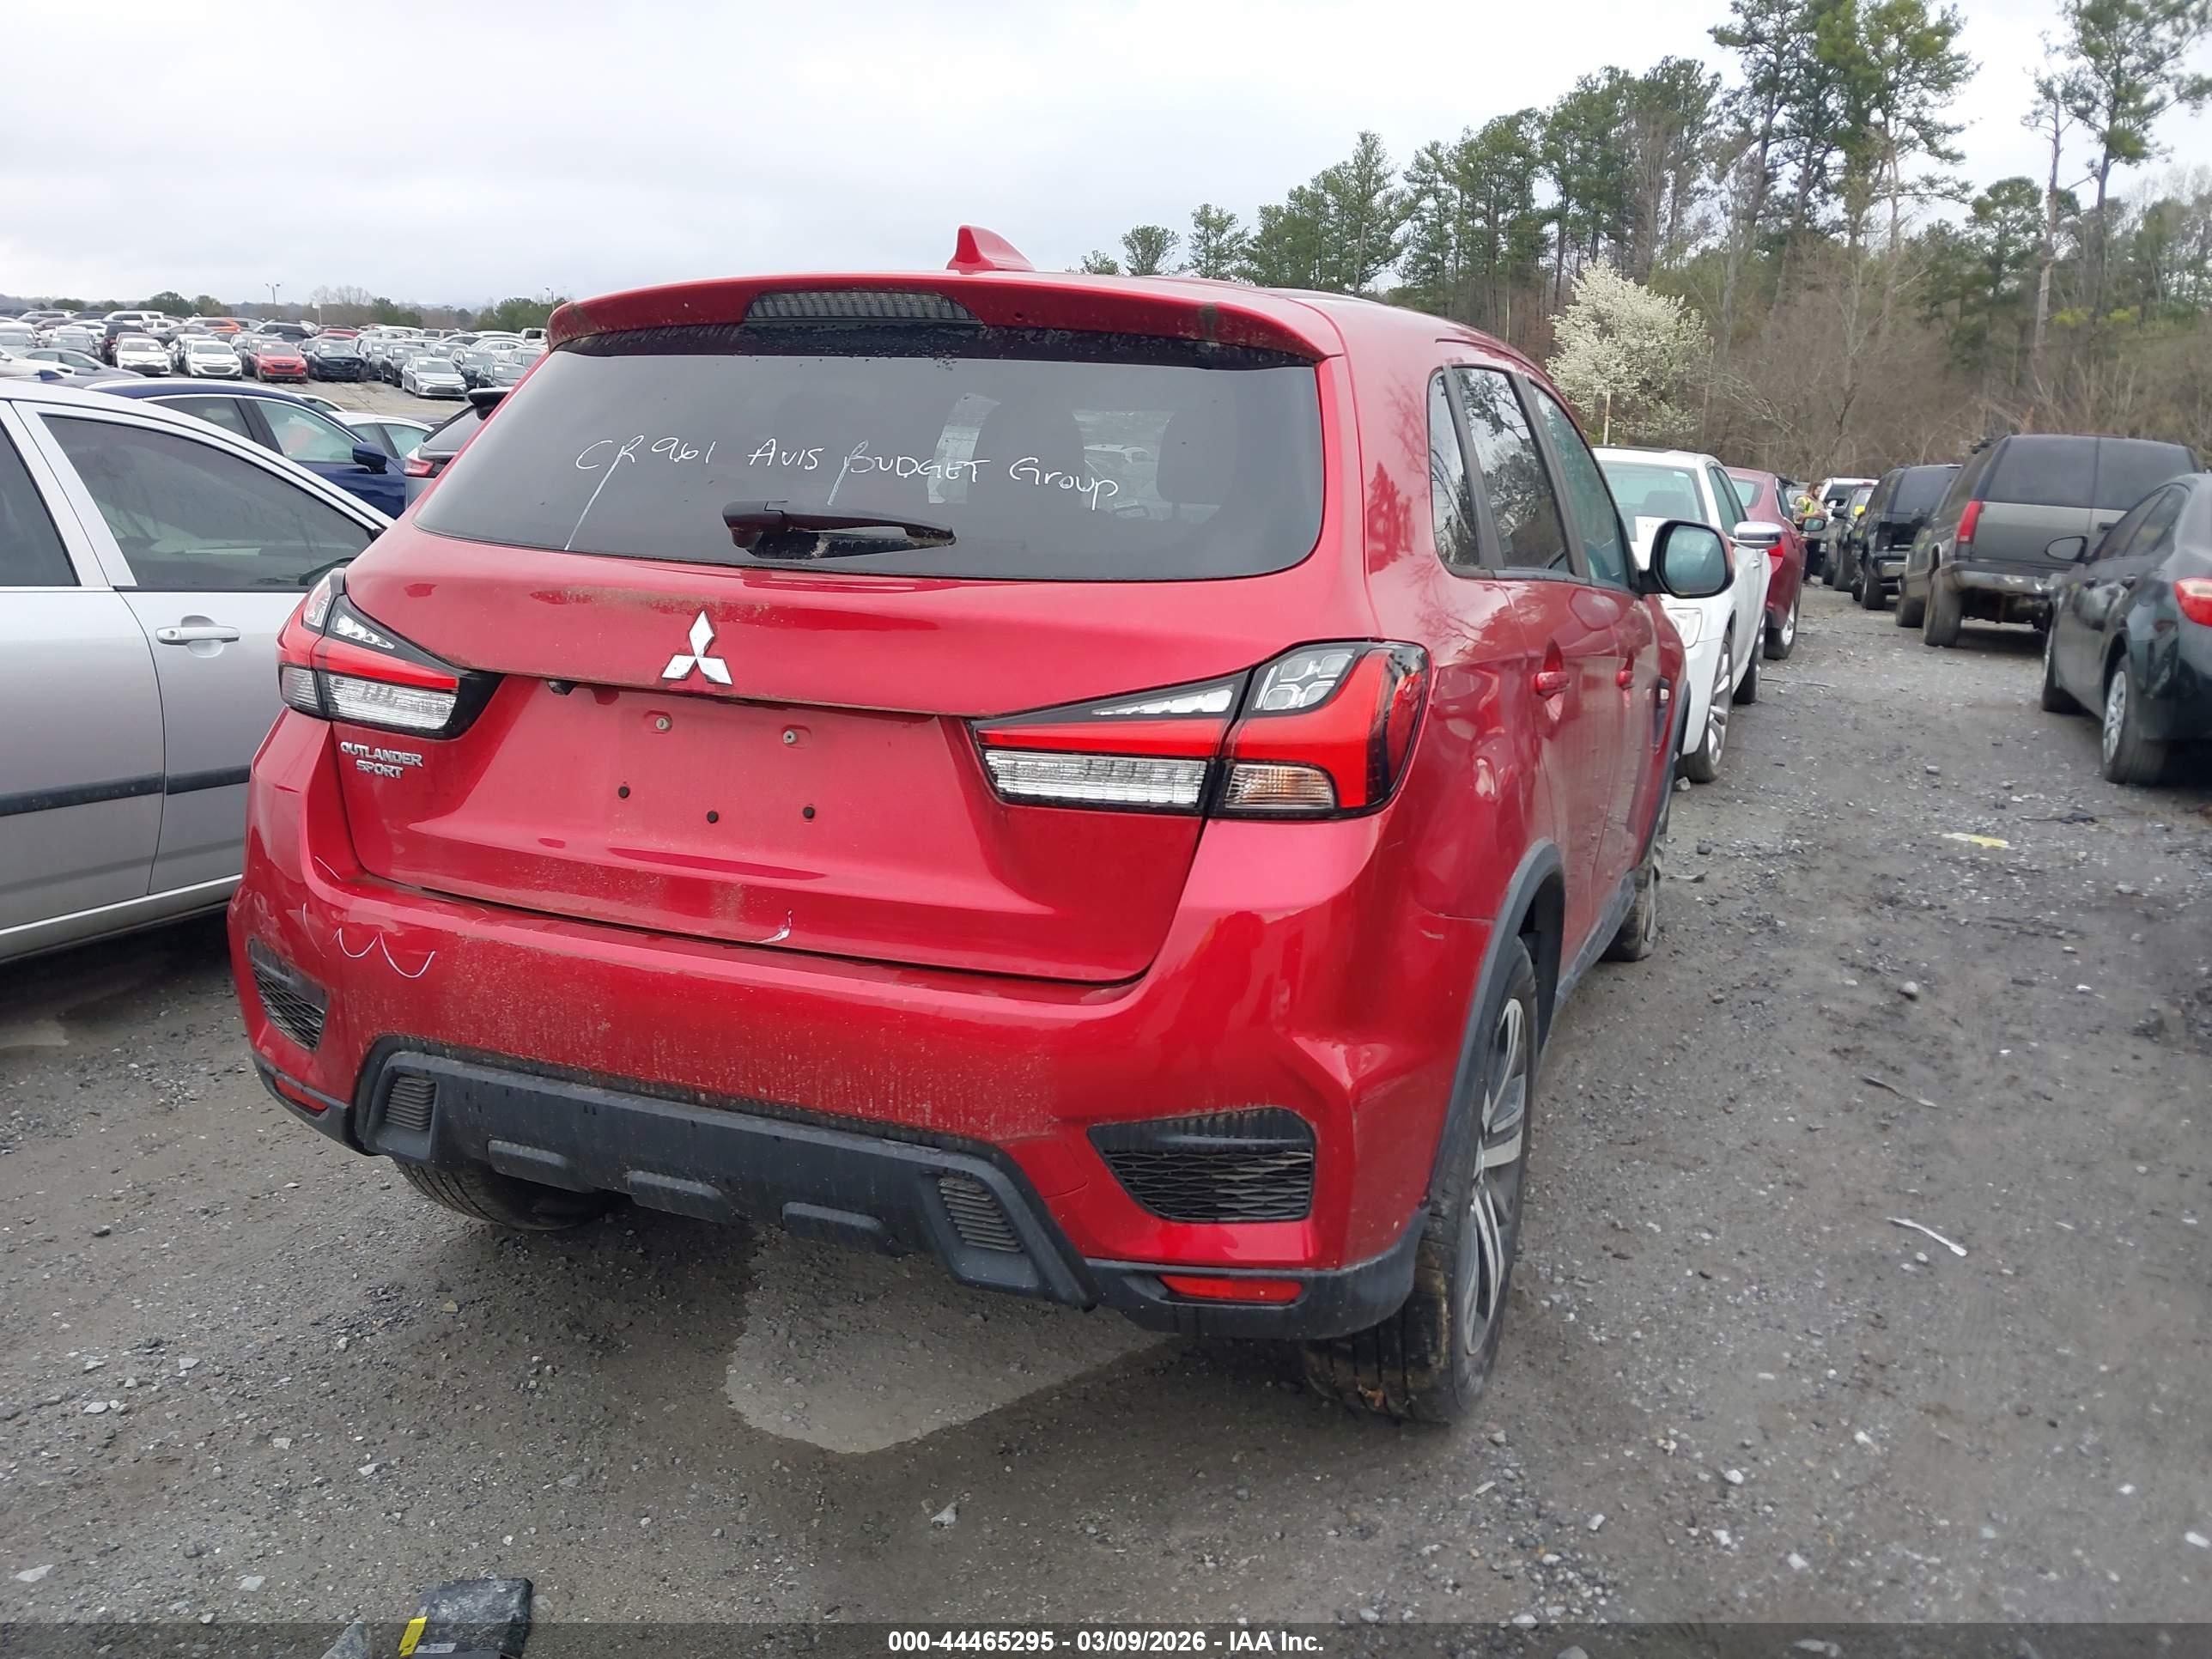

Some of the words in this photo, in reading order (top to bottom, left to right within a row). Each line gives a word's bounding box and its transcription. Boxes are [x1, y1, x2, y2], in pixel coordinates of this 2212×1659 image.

[827, 440, 991, 506] BUDGET
[1009, 457, 1119, 510] Group
[340, 741, 424, 768] OUTLANDER
[356, 759, 404, 779] SPORT
